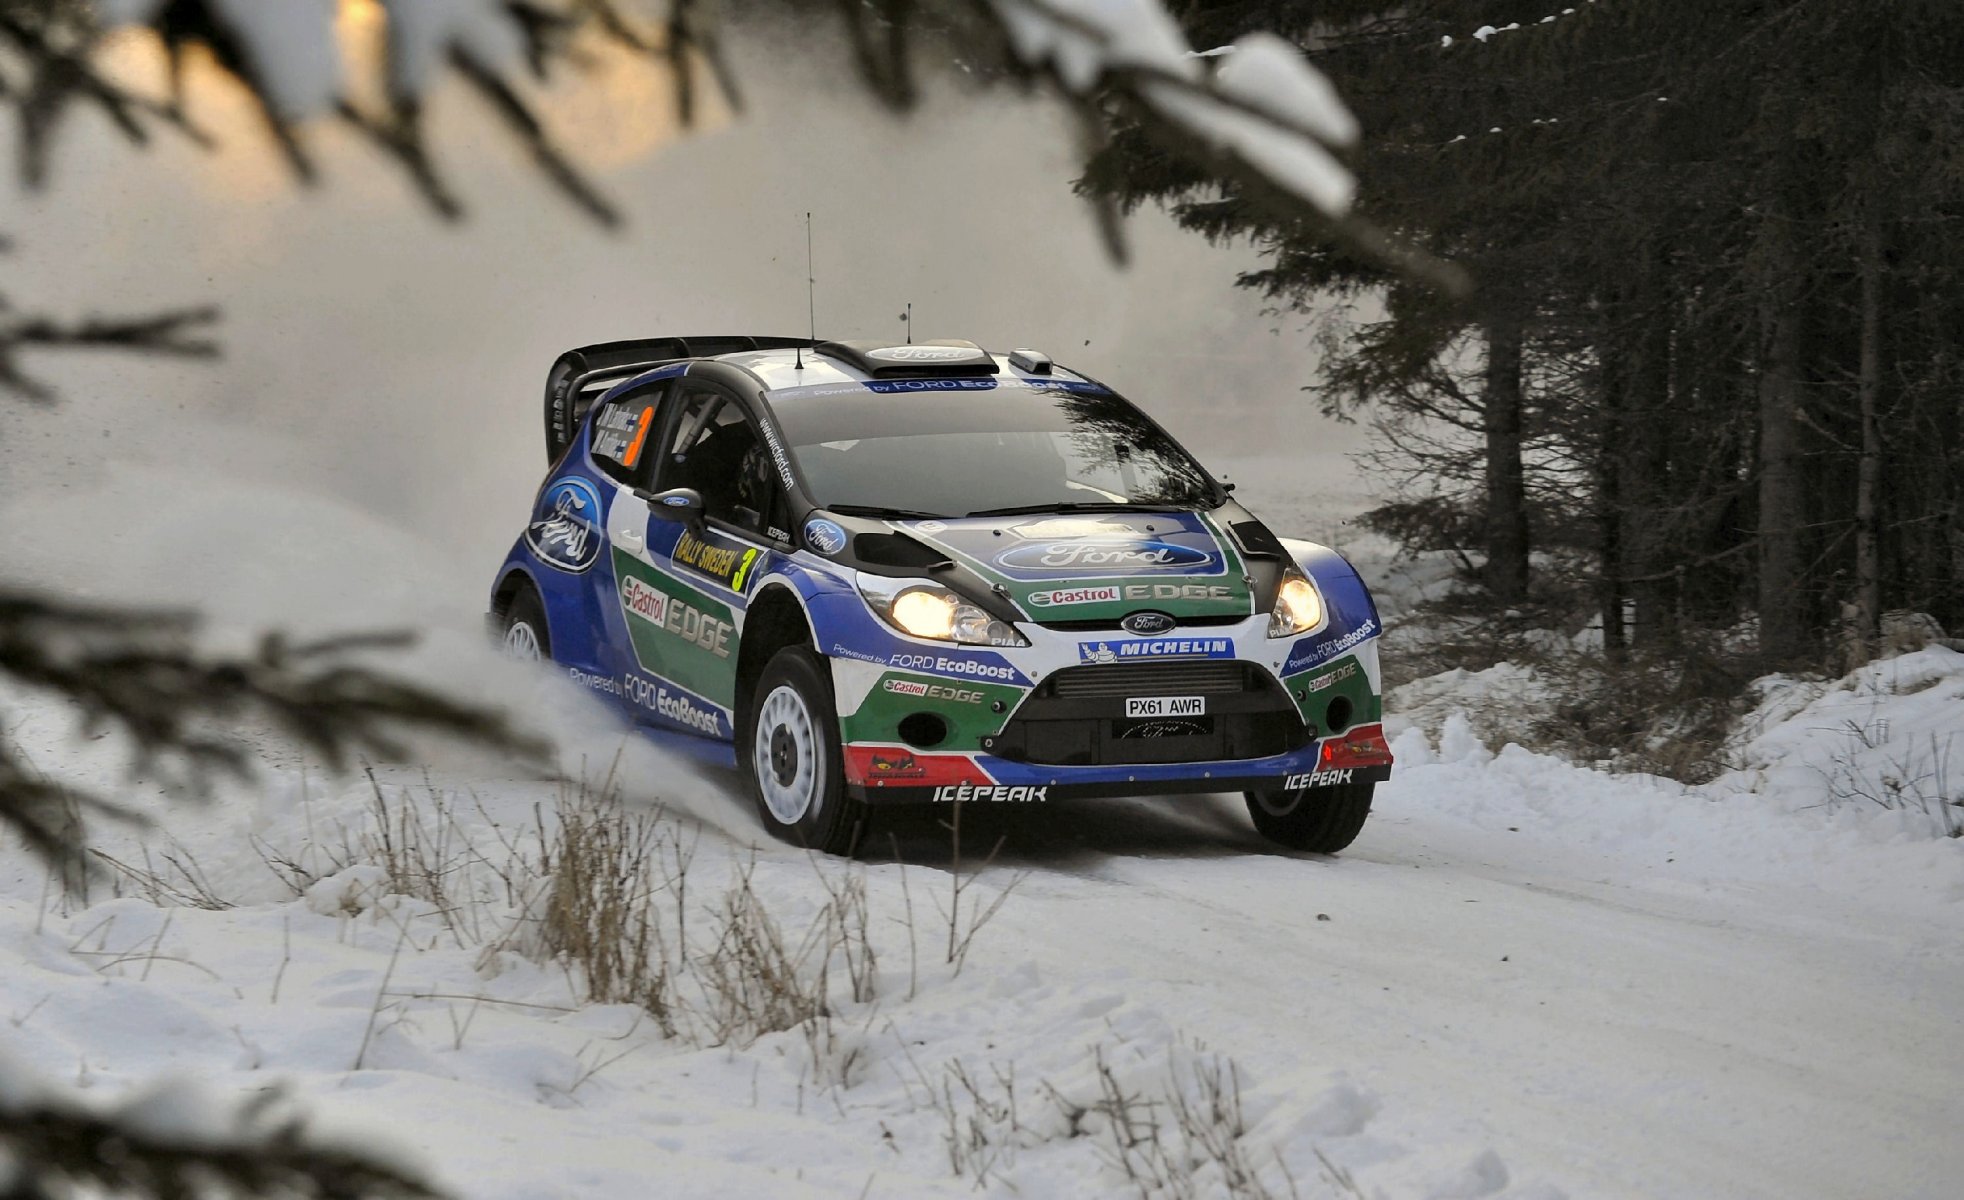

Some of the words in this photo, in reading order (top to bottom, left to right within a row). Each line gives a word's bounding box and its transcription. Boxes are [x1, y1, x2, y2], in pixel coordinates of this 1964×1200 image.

[873, 383, 889, 393] by
[893, 379, 956, 391] FORD
[530, 487, 591, 561] Ford
[809, 524, 839, 552] Ford
[675, 532, 705, 564] RALLY
[698, 545, 739, 577] SWEDEN
[1041, 543, 1175, 566] Ford
[732, 547, 757, 592] 3
[1051, 587, 1116, 604] Castrol
[1124, 584, 1234, 600] EDGE
[632, 584, 664, 622] Castrol
[665, 598, 733, 658] EDGE
[1134, 616, 1164, 629] Ford
[991, 638, 1026, 647] PIAA
[1120, 640, 1227, 656] MICHELIN
[1289, 655, 1313, 669] Powered
[1316, 640, 1337, 658] FORD
[1333, 618, 1376, 651] EcoBoost
[833, 643, 876, 663] Powered
[873, 656, 887, 666] by
[889, 654, 935, 670] FORD
[936, 657, 1015, 681] EcoBoost
[1331, 662, 1357, 684] EDGE
[570, 667, 615, 693] Powered
[624, 672, 656, 711] FORD
[657, 688, 721, 737] EcoBoost
[893, 681, 926, 695] Castrol
[928, 685, 985, 703] EDGE
[1129, 700, 1162, 715] PX61
[1169, 699, 1202, 714] AWR
[1284, 769, 1353, 790] ICEPEAK
[933, 786, 1048, 802] ICEPEAK
